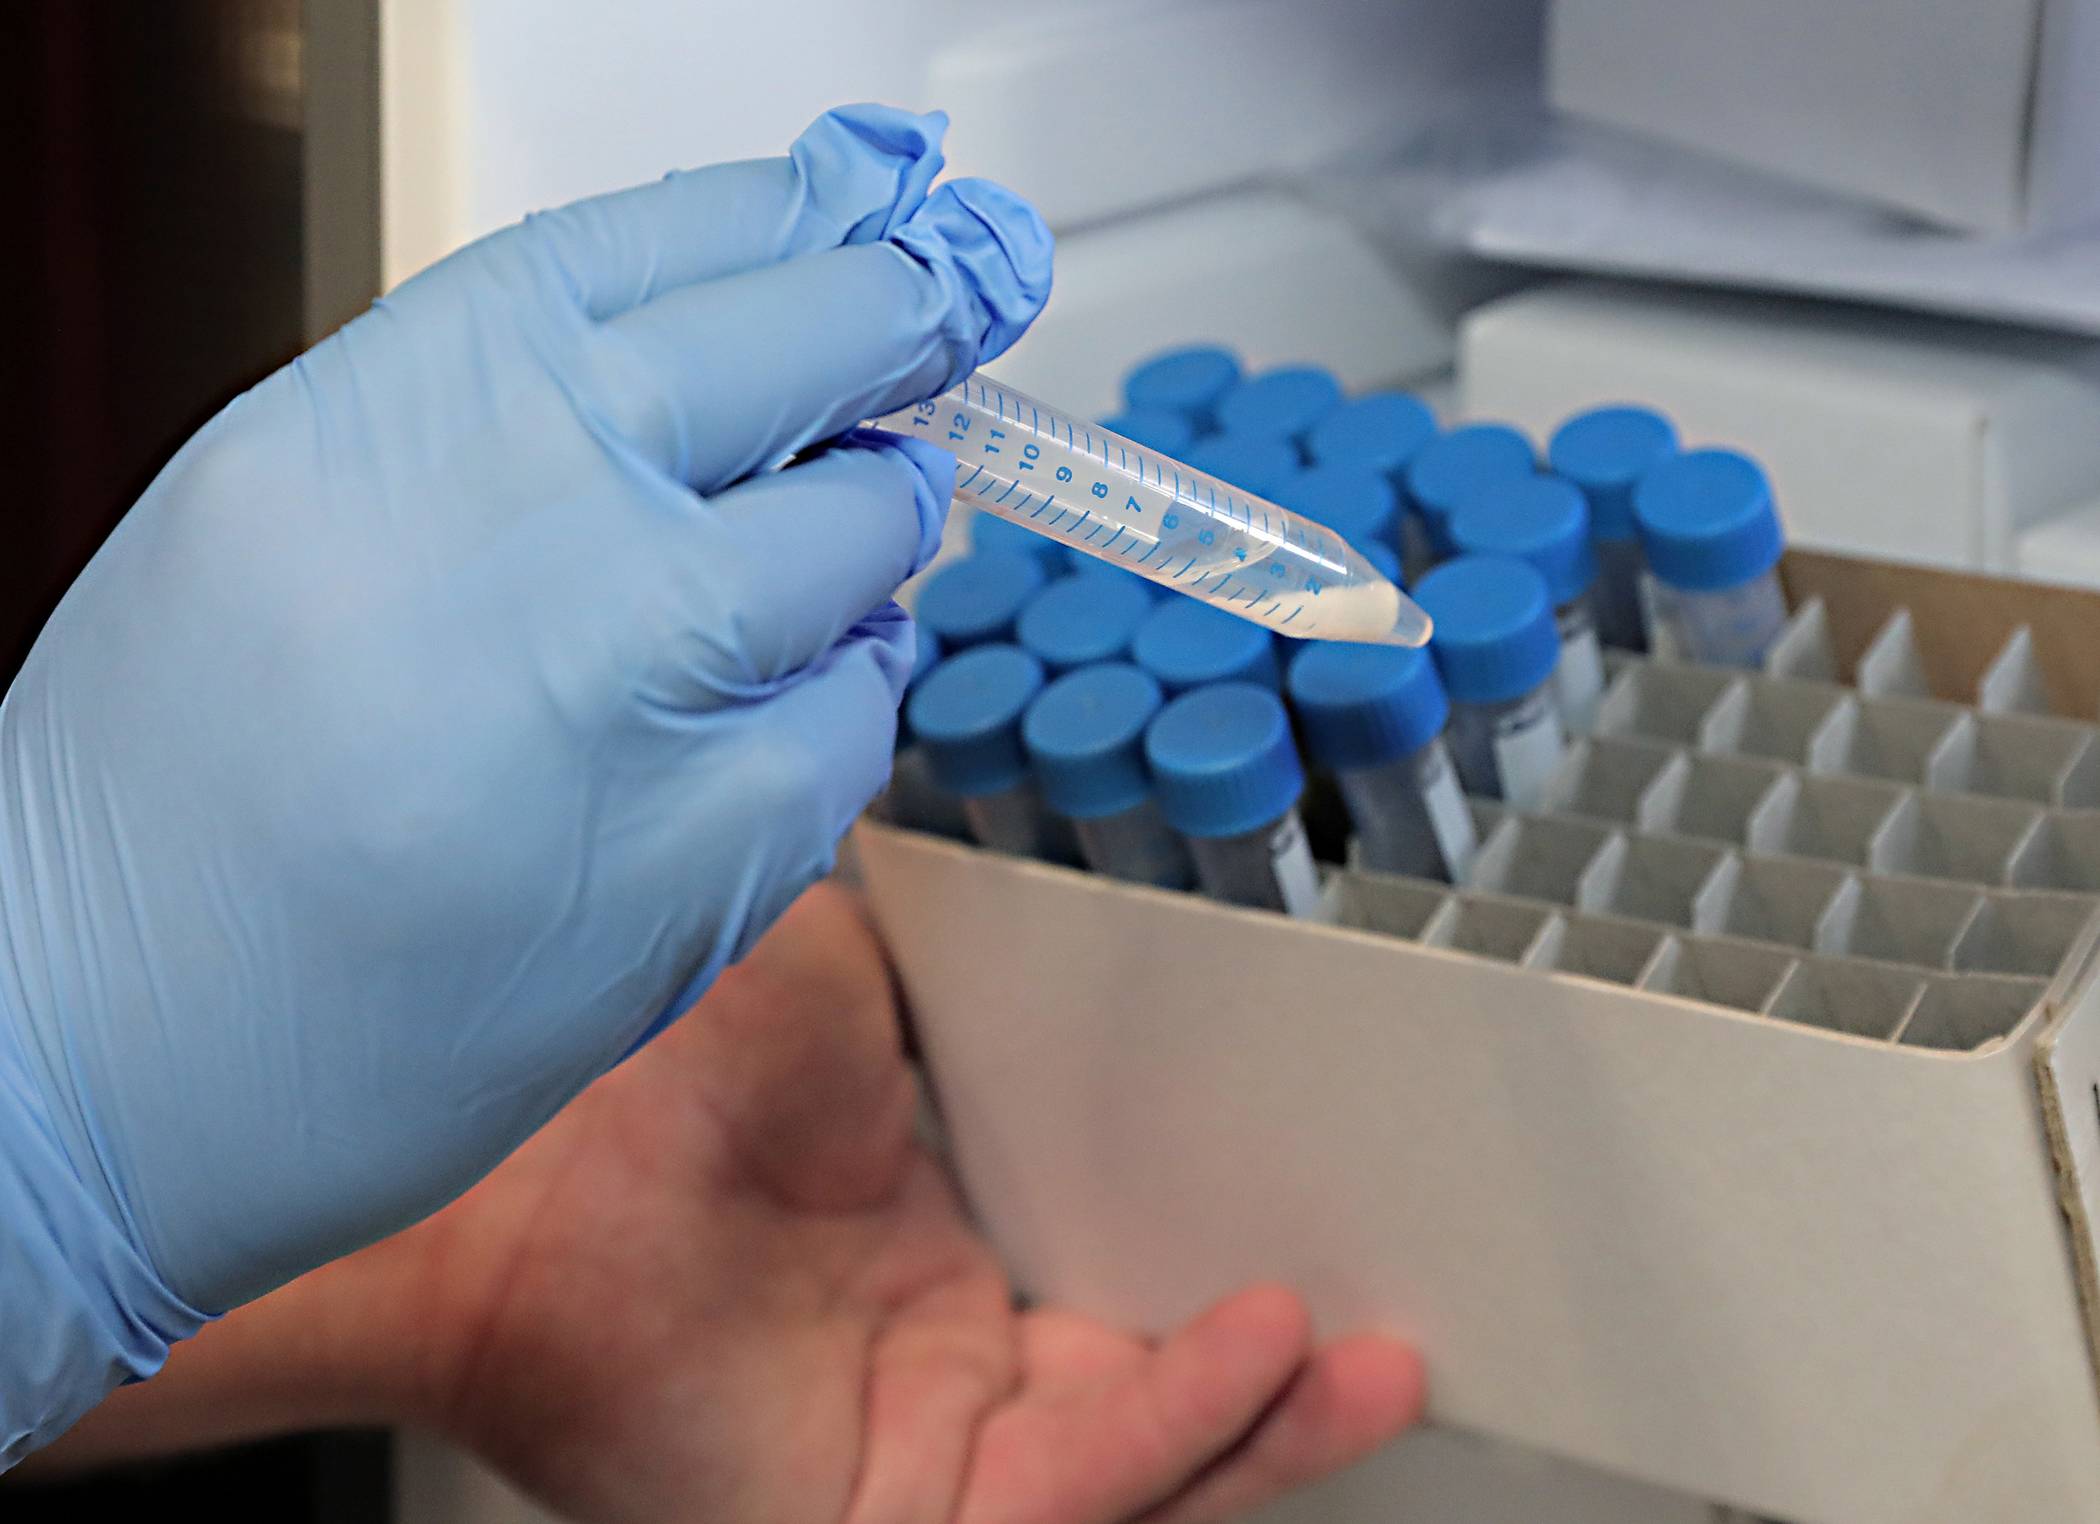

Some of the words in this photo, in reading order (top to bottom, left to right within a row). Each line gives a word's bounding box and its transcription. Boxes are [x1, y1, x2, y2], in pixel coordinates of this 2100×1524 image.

[912, 399, 936, 426] 13
[948, 412, 971, 440] 12
[984, 428, 1006, 454] 11
[1018, 443, 1040, 472] 10
[1055, 466, 1073, 483] 9
[1091, 481, 1109, 499] 8
[1125, 496, 1142, 513] 7
[1163, 513, 1179, 530] 6
[1198, 528, 1214, 546] 5
[1233, 547, 1248, 562] 4
[1269, 562, 1286, 578] 3
[1304, 575, 1322, 596] 2
